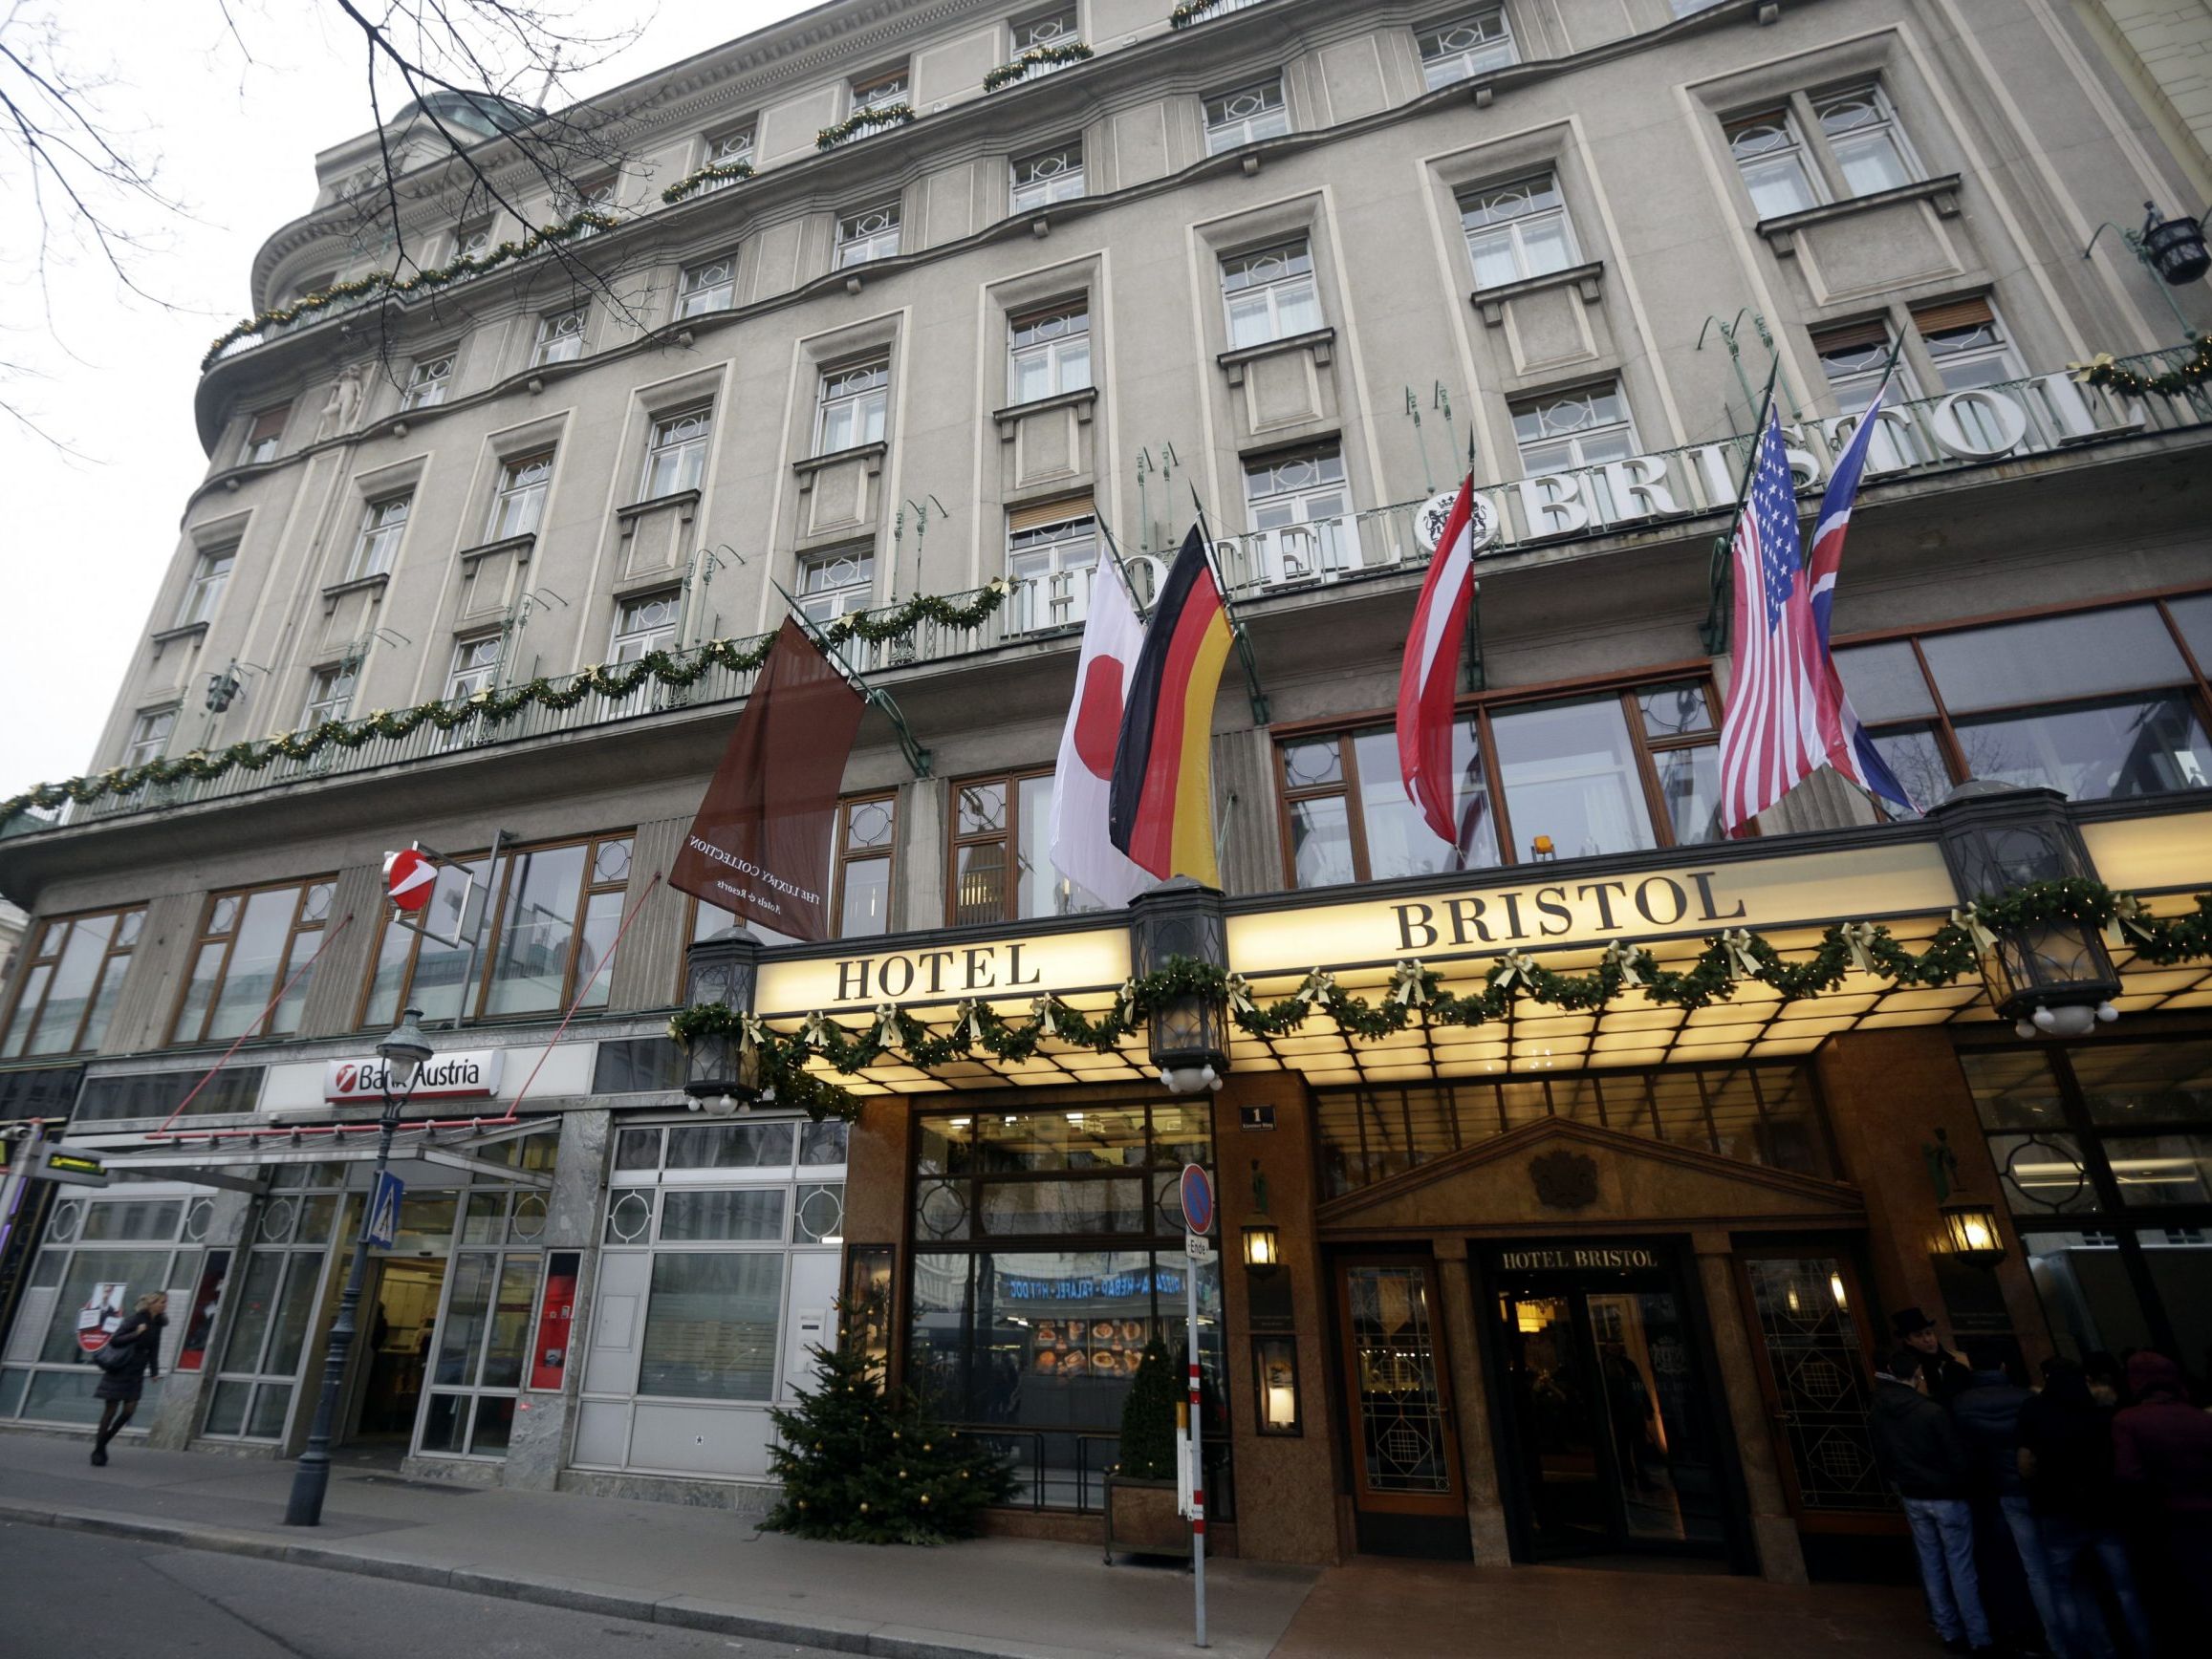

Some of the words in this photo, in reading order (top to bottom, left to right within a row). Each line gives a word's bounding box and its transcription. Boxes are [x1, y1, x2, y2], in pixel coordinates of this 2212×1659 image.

[833, 943, 1041, 1002] HOTEL
[1390, 872, 1746, 951] BRISTOL
[415, 1058, 479, 1088] Austria
[1253, 1109, 1261, 1122] 1
[1503, 1251, 1569, 1269] HOTEL
[1574, 1250, 1658, 1268] BRISTOL
